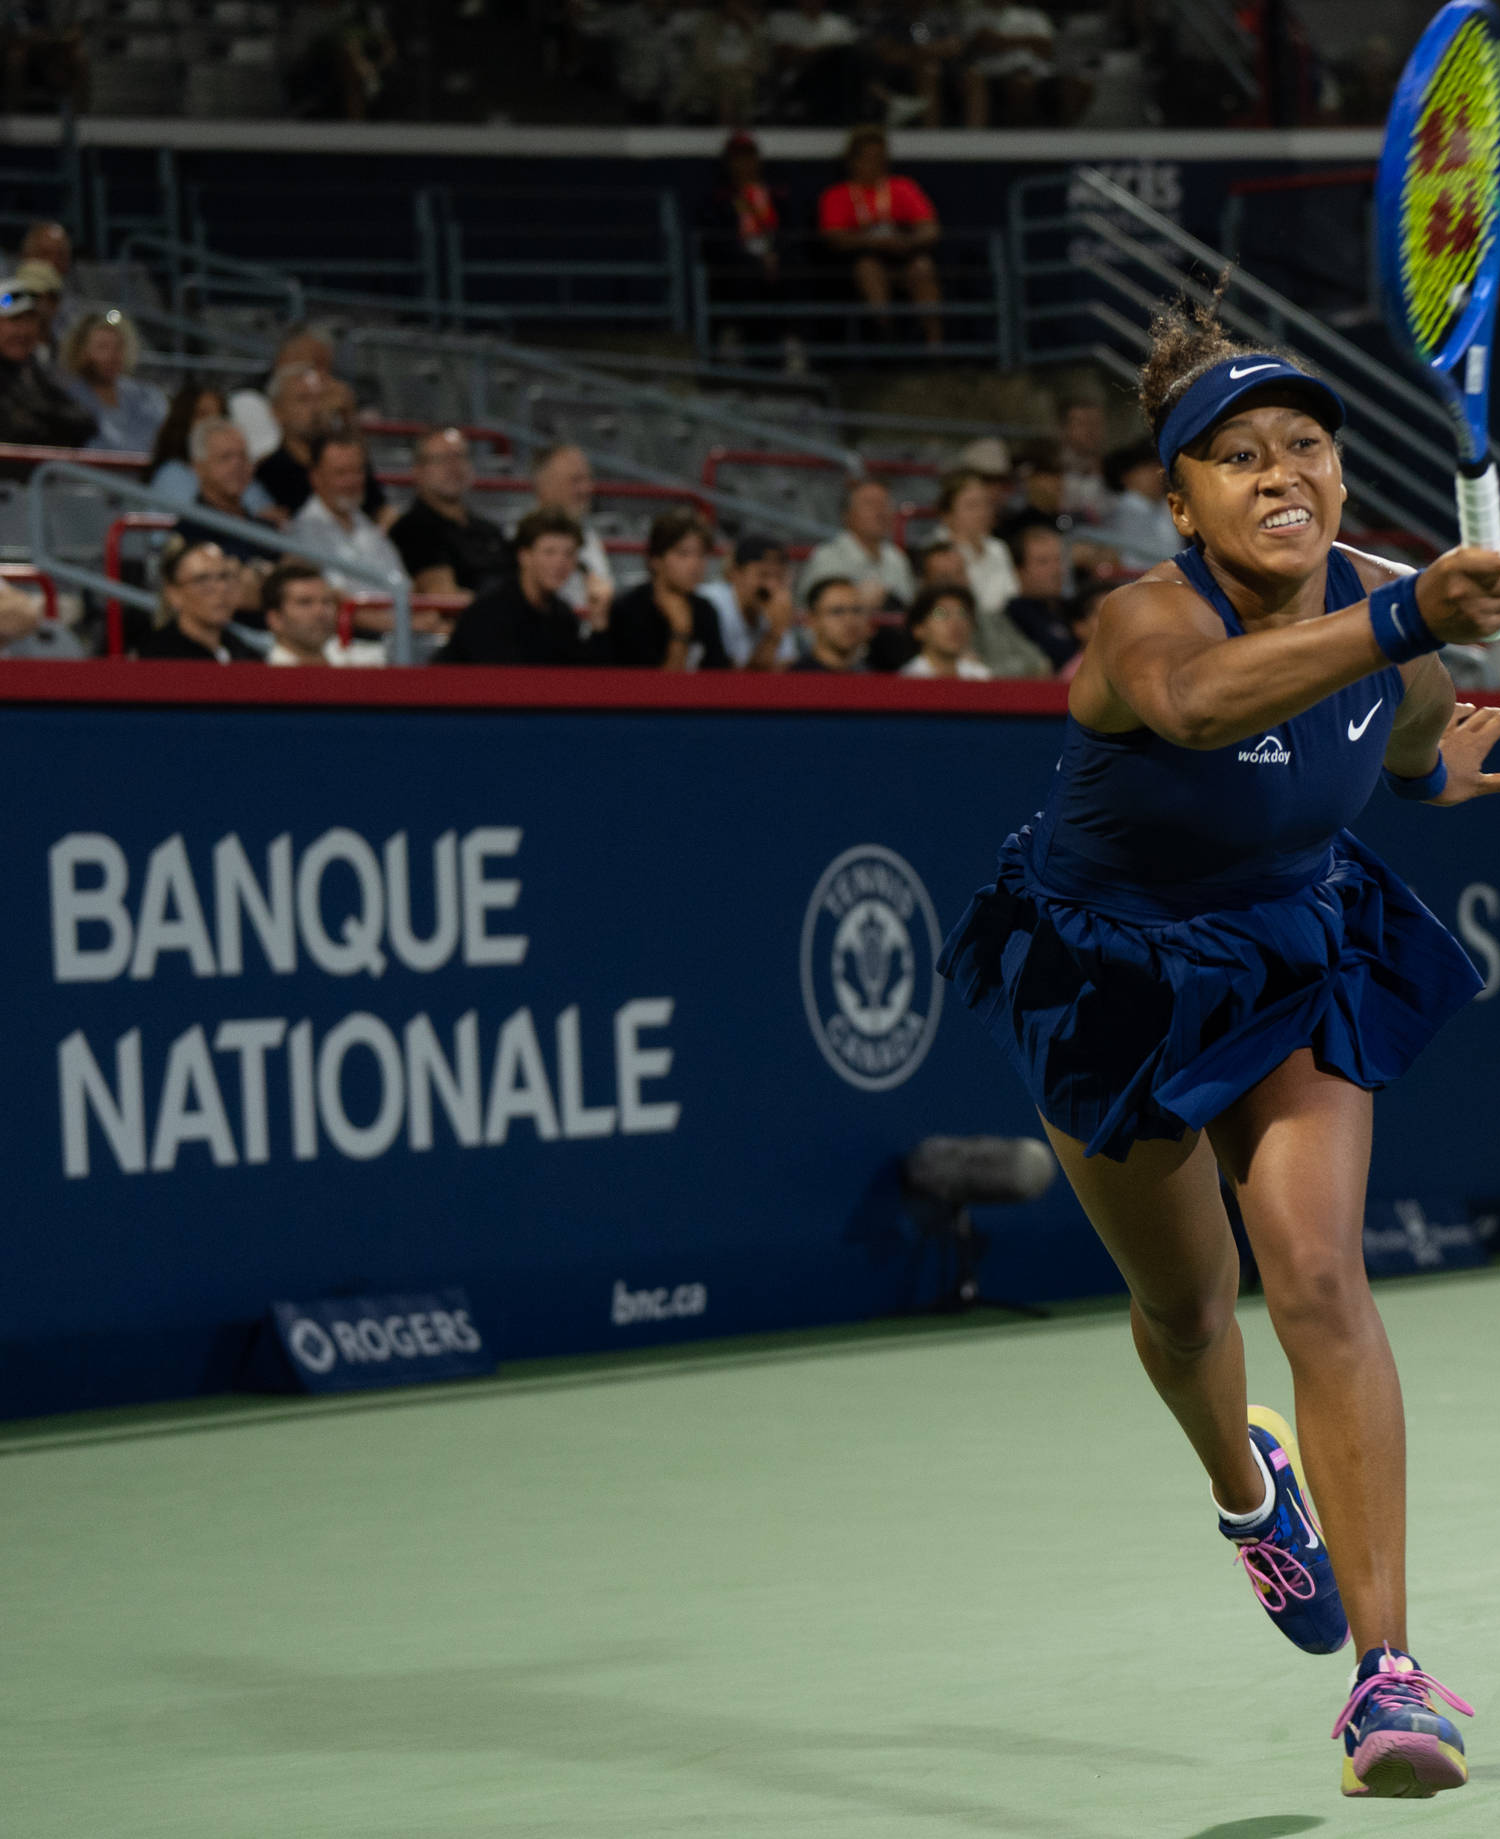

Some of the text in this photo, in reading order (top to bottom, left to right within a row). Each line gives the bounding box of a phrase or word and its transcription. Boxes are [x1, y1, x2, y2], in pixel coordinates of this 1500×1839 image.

[1237, 748, 1292, 766] workday
[48, 826, 530, 983] BANQUE
[58, 997, 684, 1179] NATIONALE
[611, 1280, 708, 1326] bnc.ca
[331, 1309, 482, 1366] ROGERS
